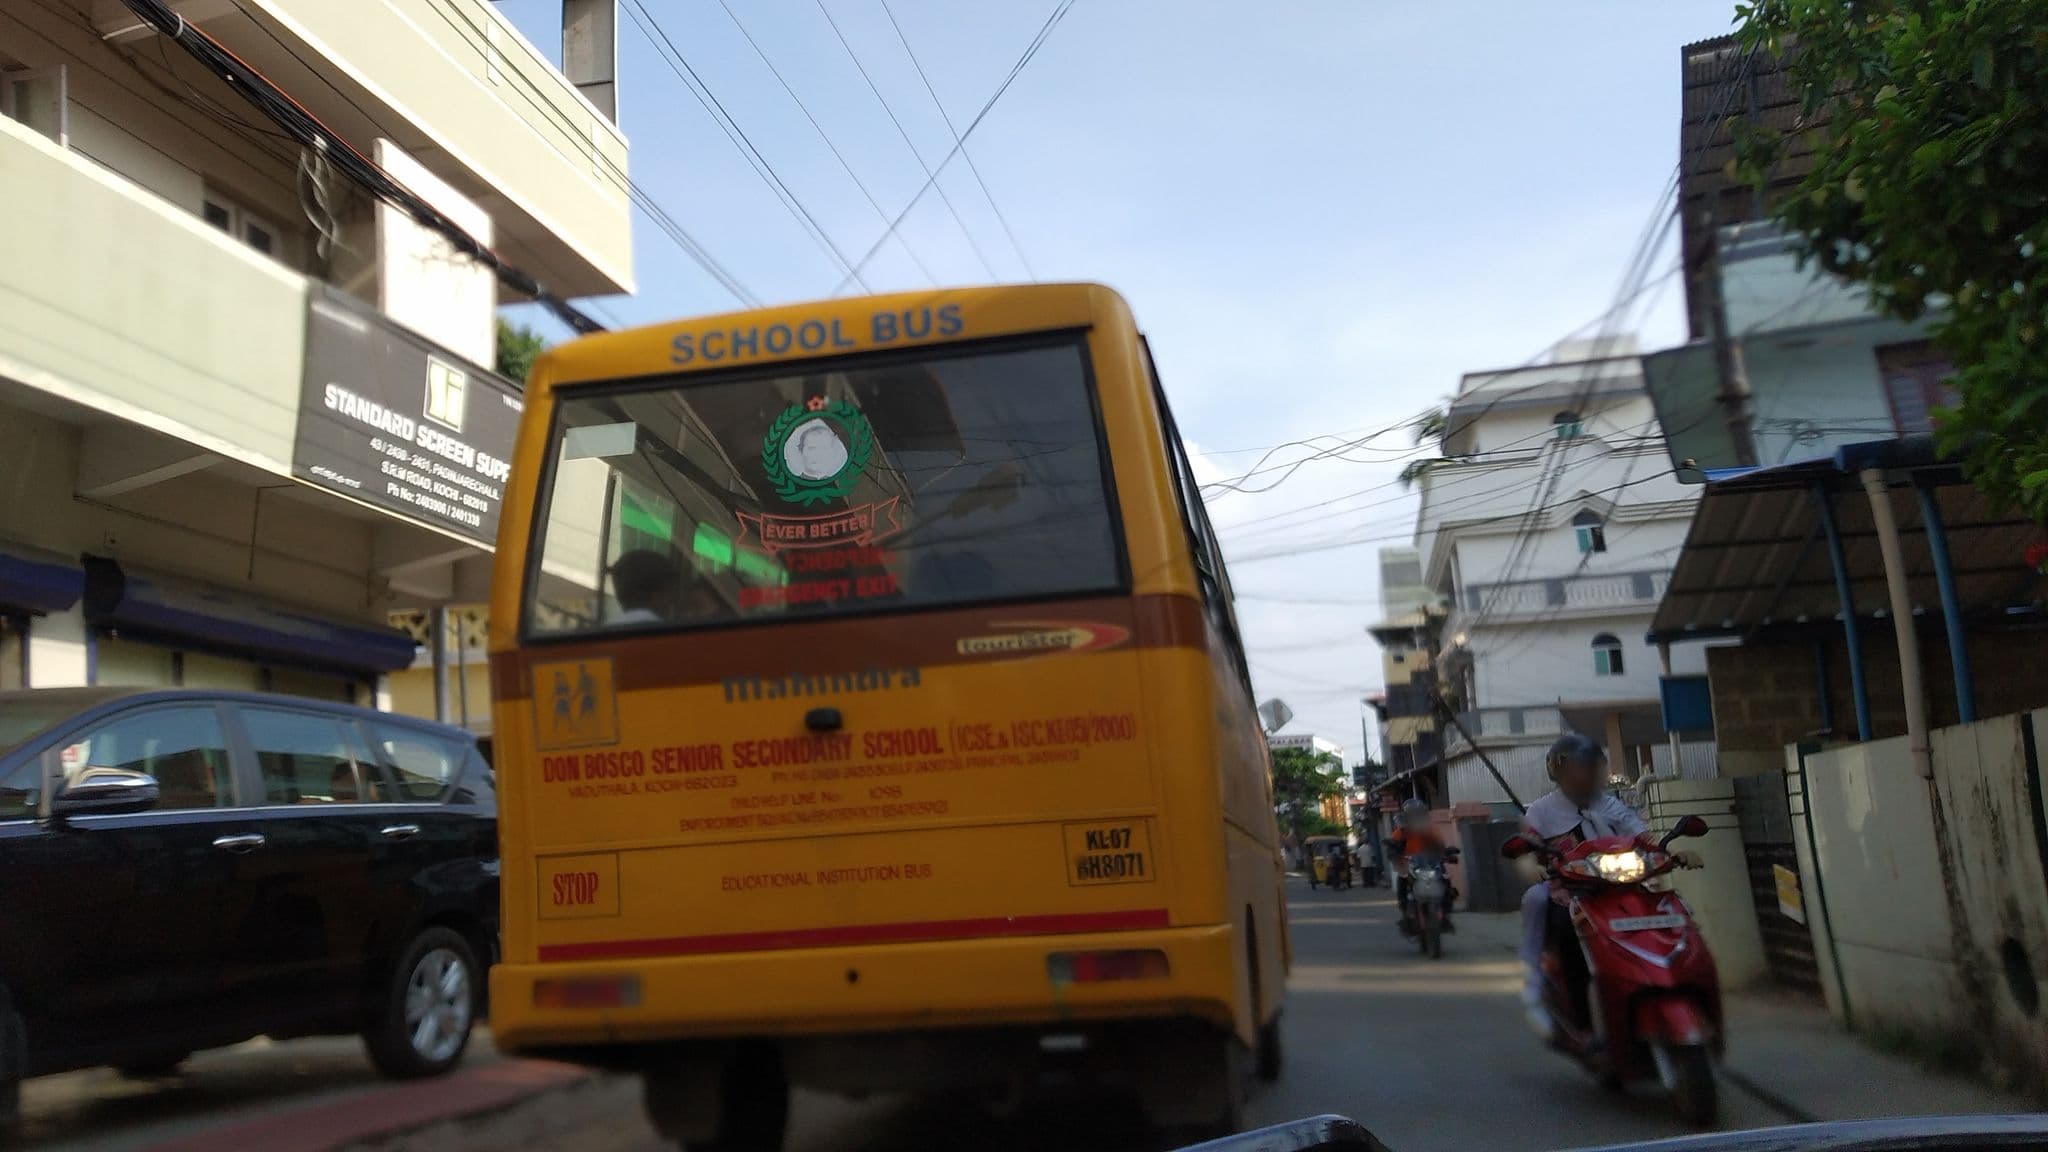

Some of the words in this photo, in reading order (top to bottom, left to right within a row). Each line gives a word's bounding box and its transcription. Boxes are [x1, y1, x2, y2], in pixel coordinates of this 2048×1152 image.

[671, 318, 855, 364] SCHOOL
[872, 304, 964, 343] BUS
[324, 383, 415, 441] STANDARD
[416, 424, 475, 468] SCREEN
[386, 482, 399, 498] Ph
[434, 480, 459, 499] KOCHI
[766, 522, 806, 539] EVER
[810, 515, 867, 537] BETTER
[856, 574, 896, 596] EXIT
[722, 666, 921, 703] mahindra
[543, 755, 579, 783] DON
[584, 751, 644, 779] BOSCO
[652, 744, 723, 774] SENIOR
[732, 733, 853, 769] SECONDARY
[864, 727, 944, 759] SCHOOL
[553, 872, 599, 906] STOP
[722, 872, 812, 891] EDUCATIONAL
[817, 866, 900, 885] INSTITUTION
[905, 864, 932, 880] BUS
